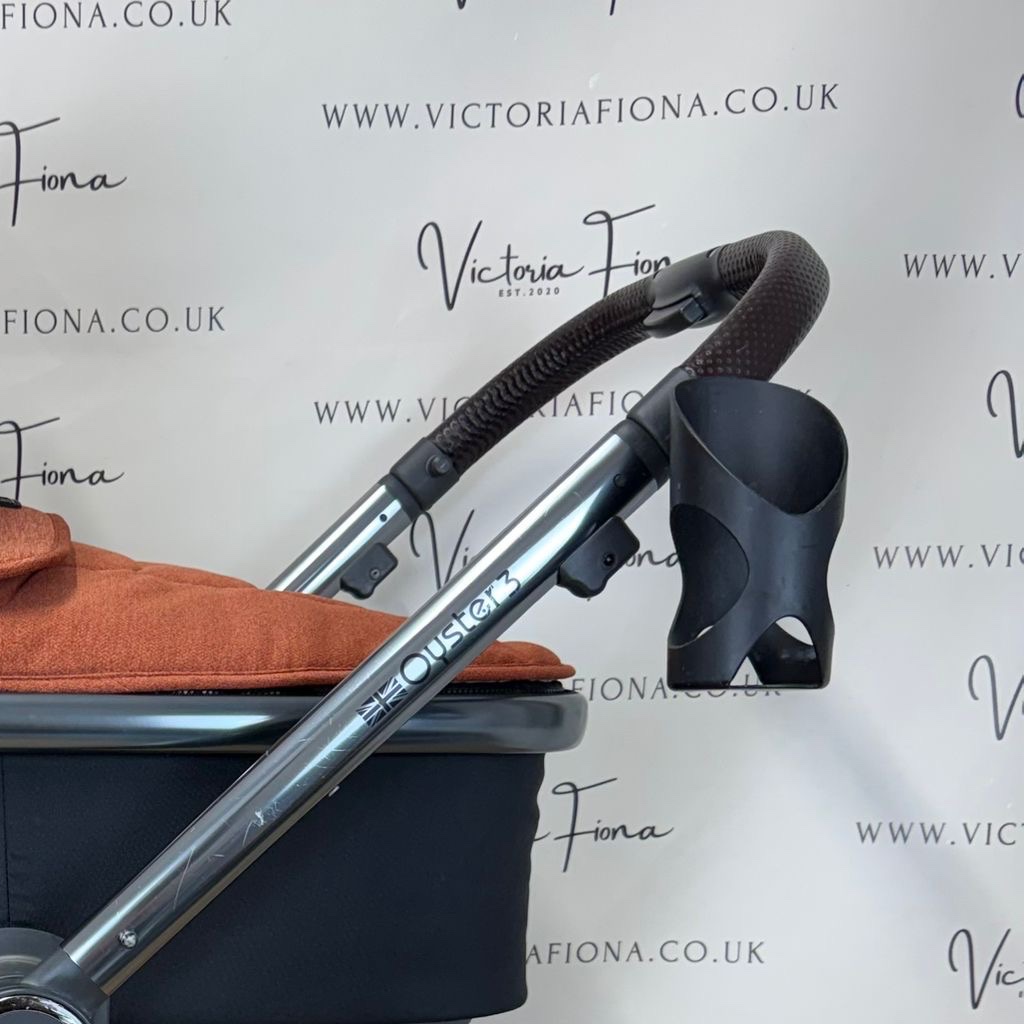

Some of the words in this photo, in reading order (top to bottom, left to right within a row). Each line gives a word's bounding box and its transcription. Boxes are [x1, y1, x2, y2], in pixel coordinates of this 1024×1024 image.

[322, 83, 841, 130] WWW.VICTORIAFIONA.CO.UK
[417, 219, 585, 312] Victoria
[582, 204, 671, 300] Fion
[498, 287, 561, 298] EST.2020
[873, 543, 1024, 569] WWW.VI
[552, 777, 675, 873] Fiona
[856, 821, 1024, 847] WWW.VIC
